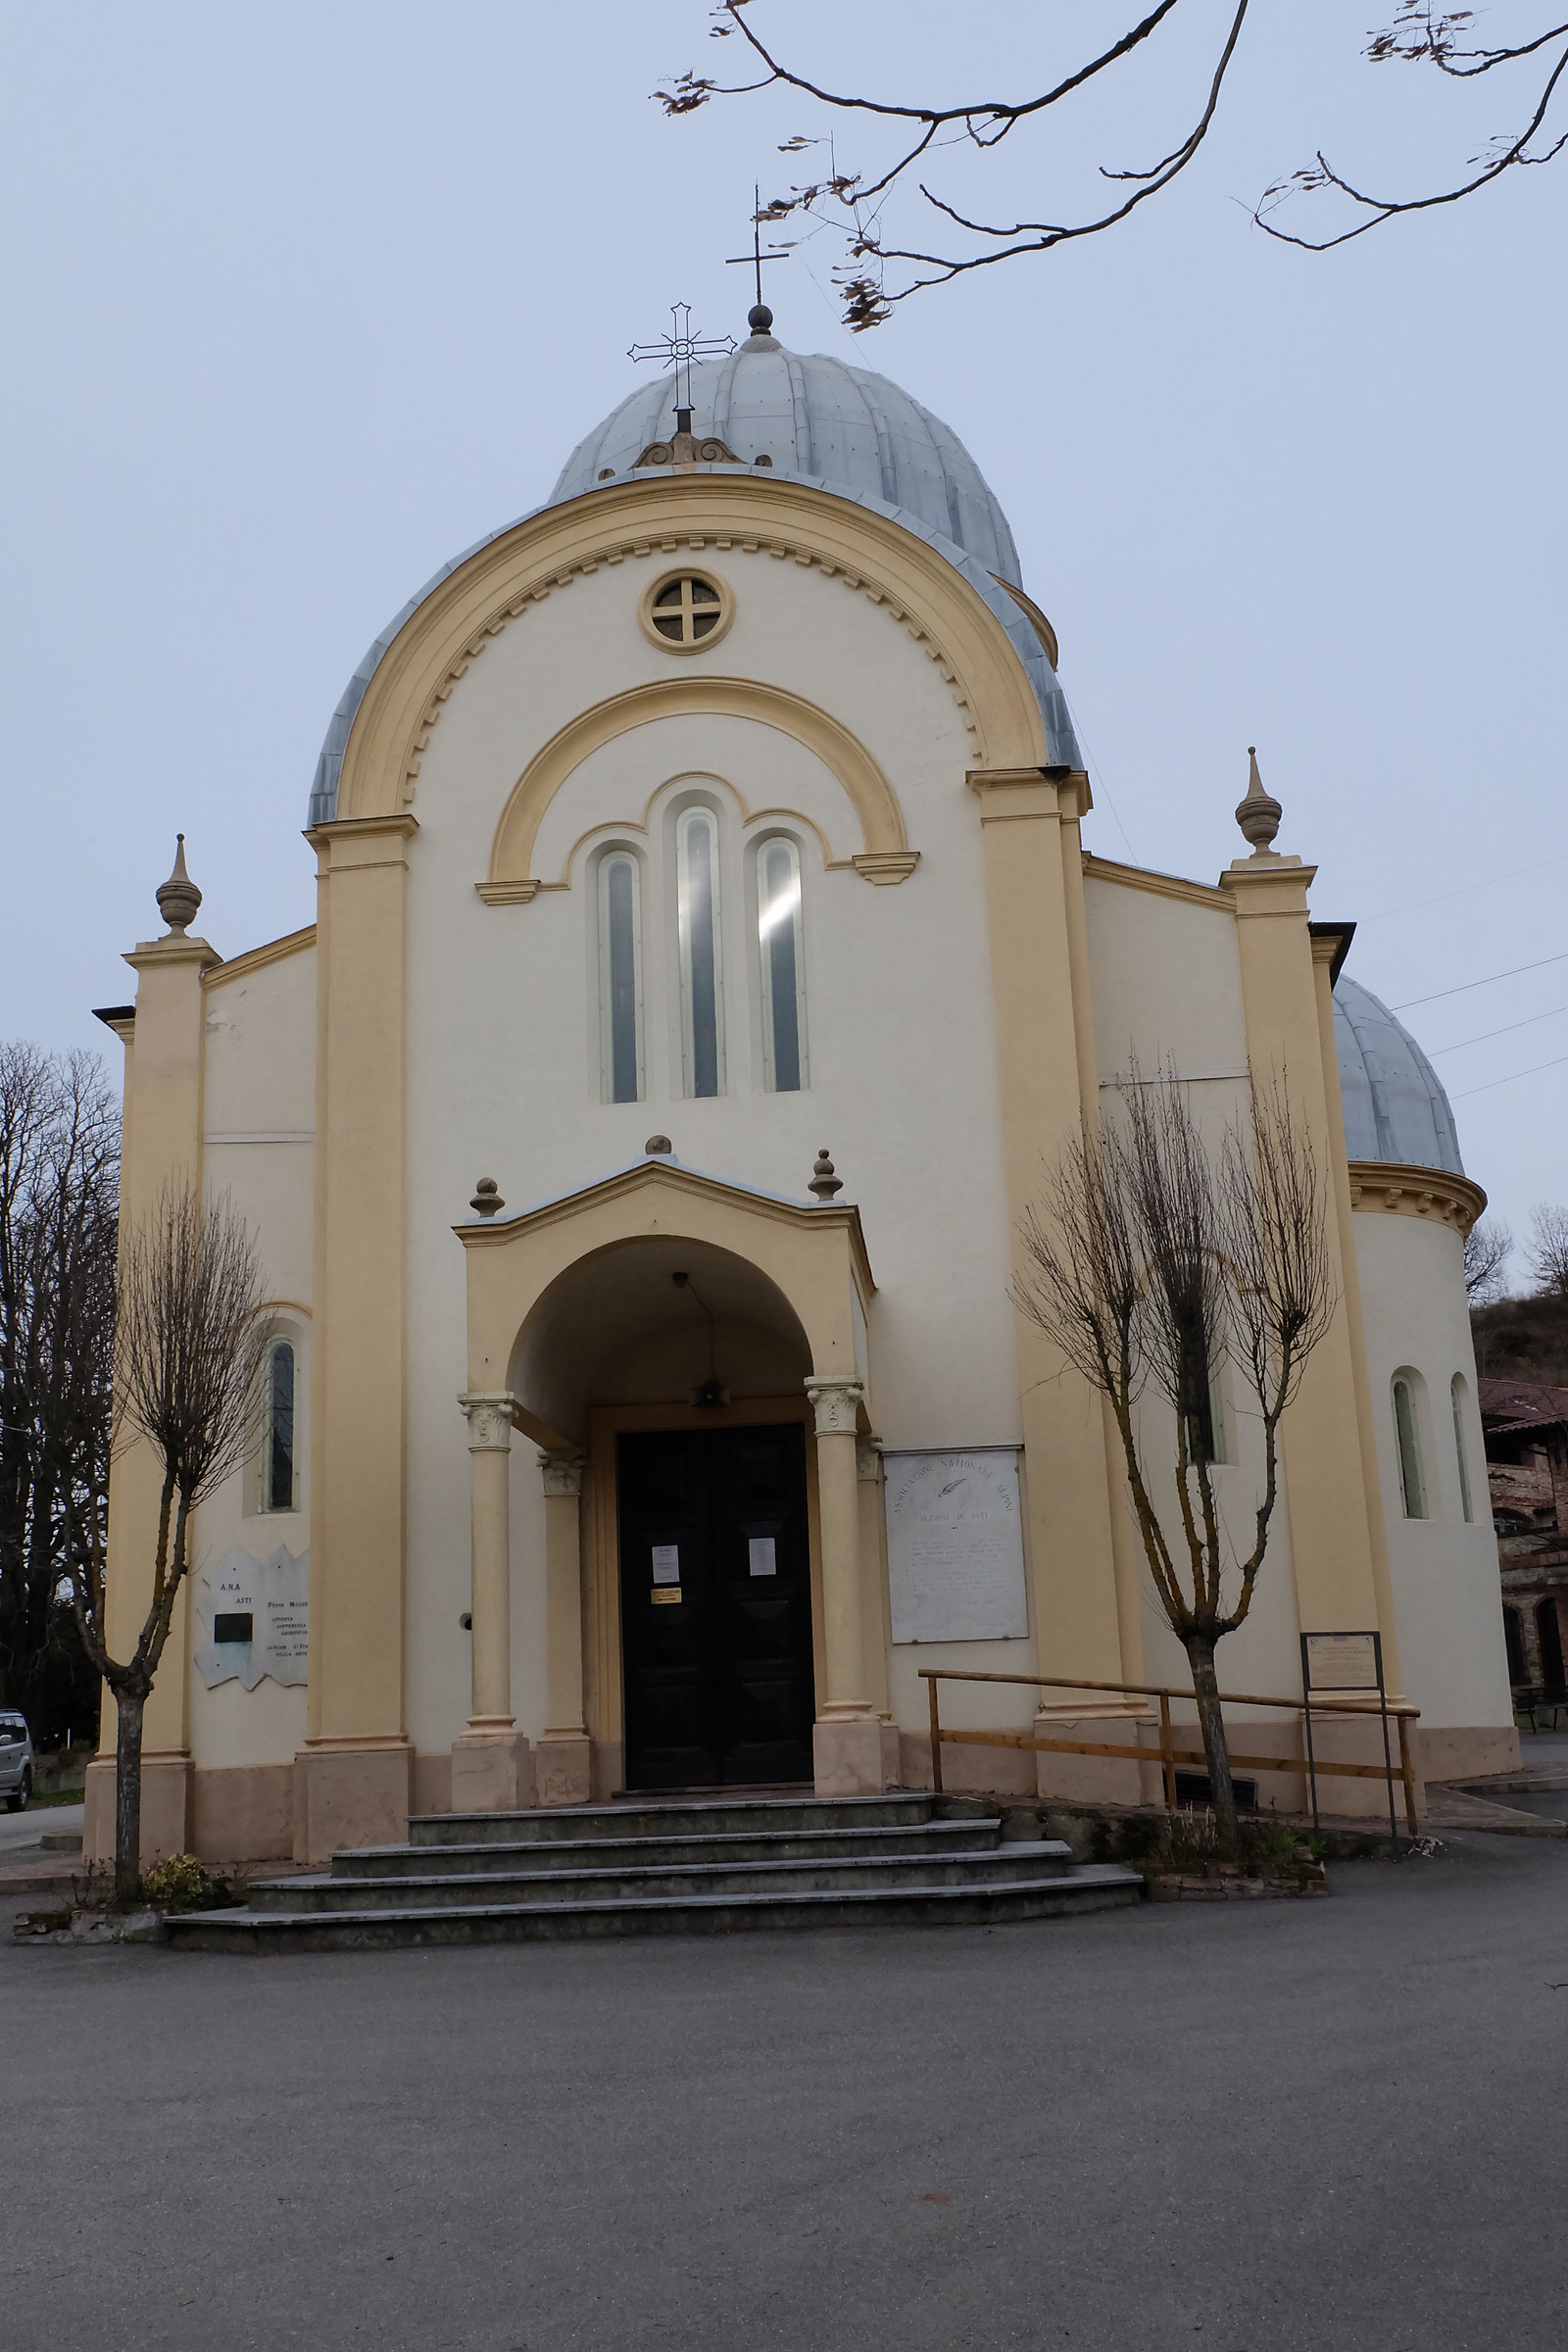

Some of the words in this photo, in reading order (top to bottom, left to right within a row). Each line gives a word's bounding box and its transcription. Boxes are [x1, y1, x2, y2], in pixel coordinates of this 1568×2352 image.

[894, 1465, 934, 1514] ASSOCIAZIONE
[941, 1458, 995, 1480] NAZIONALE
[996, 1484, 1014, 1512] ALPINI
